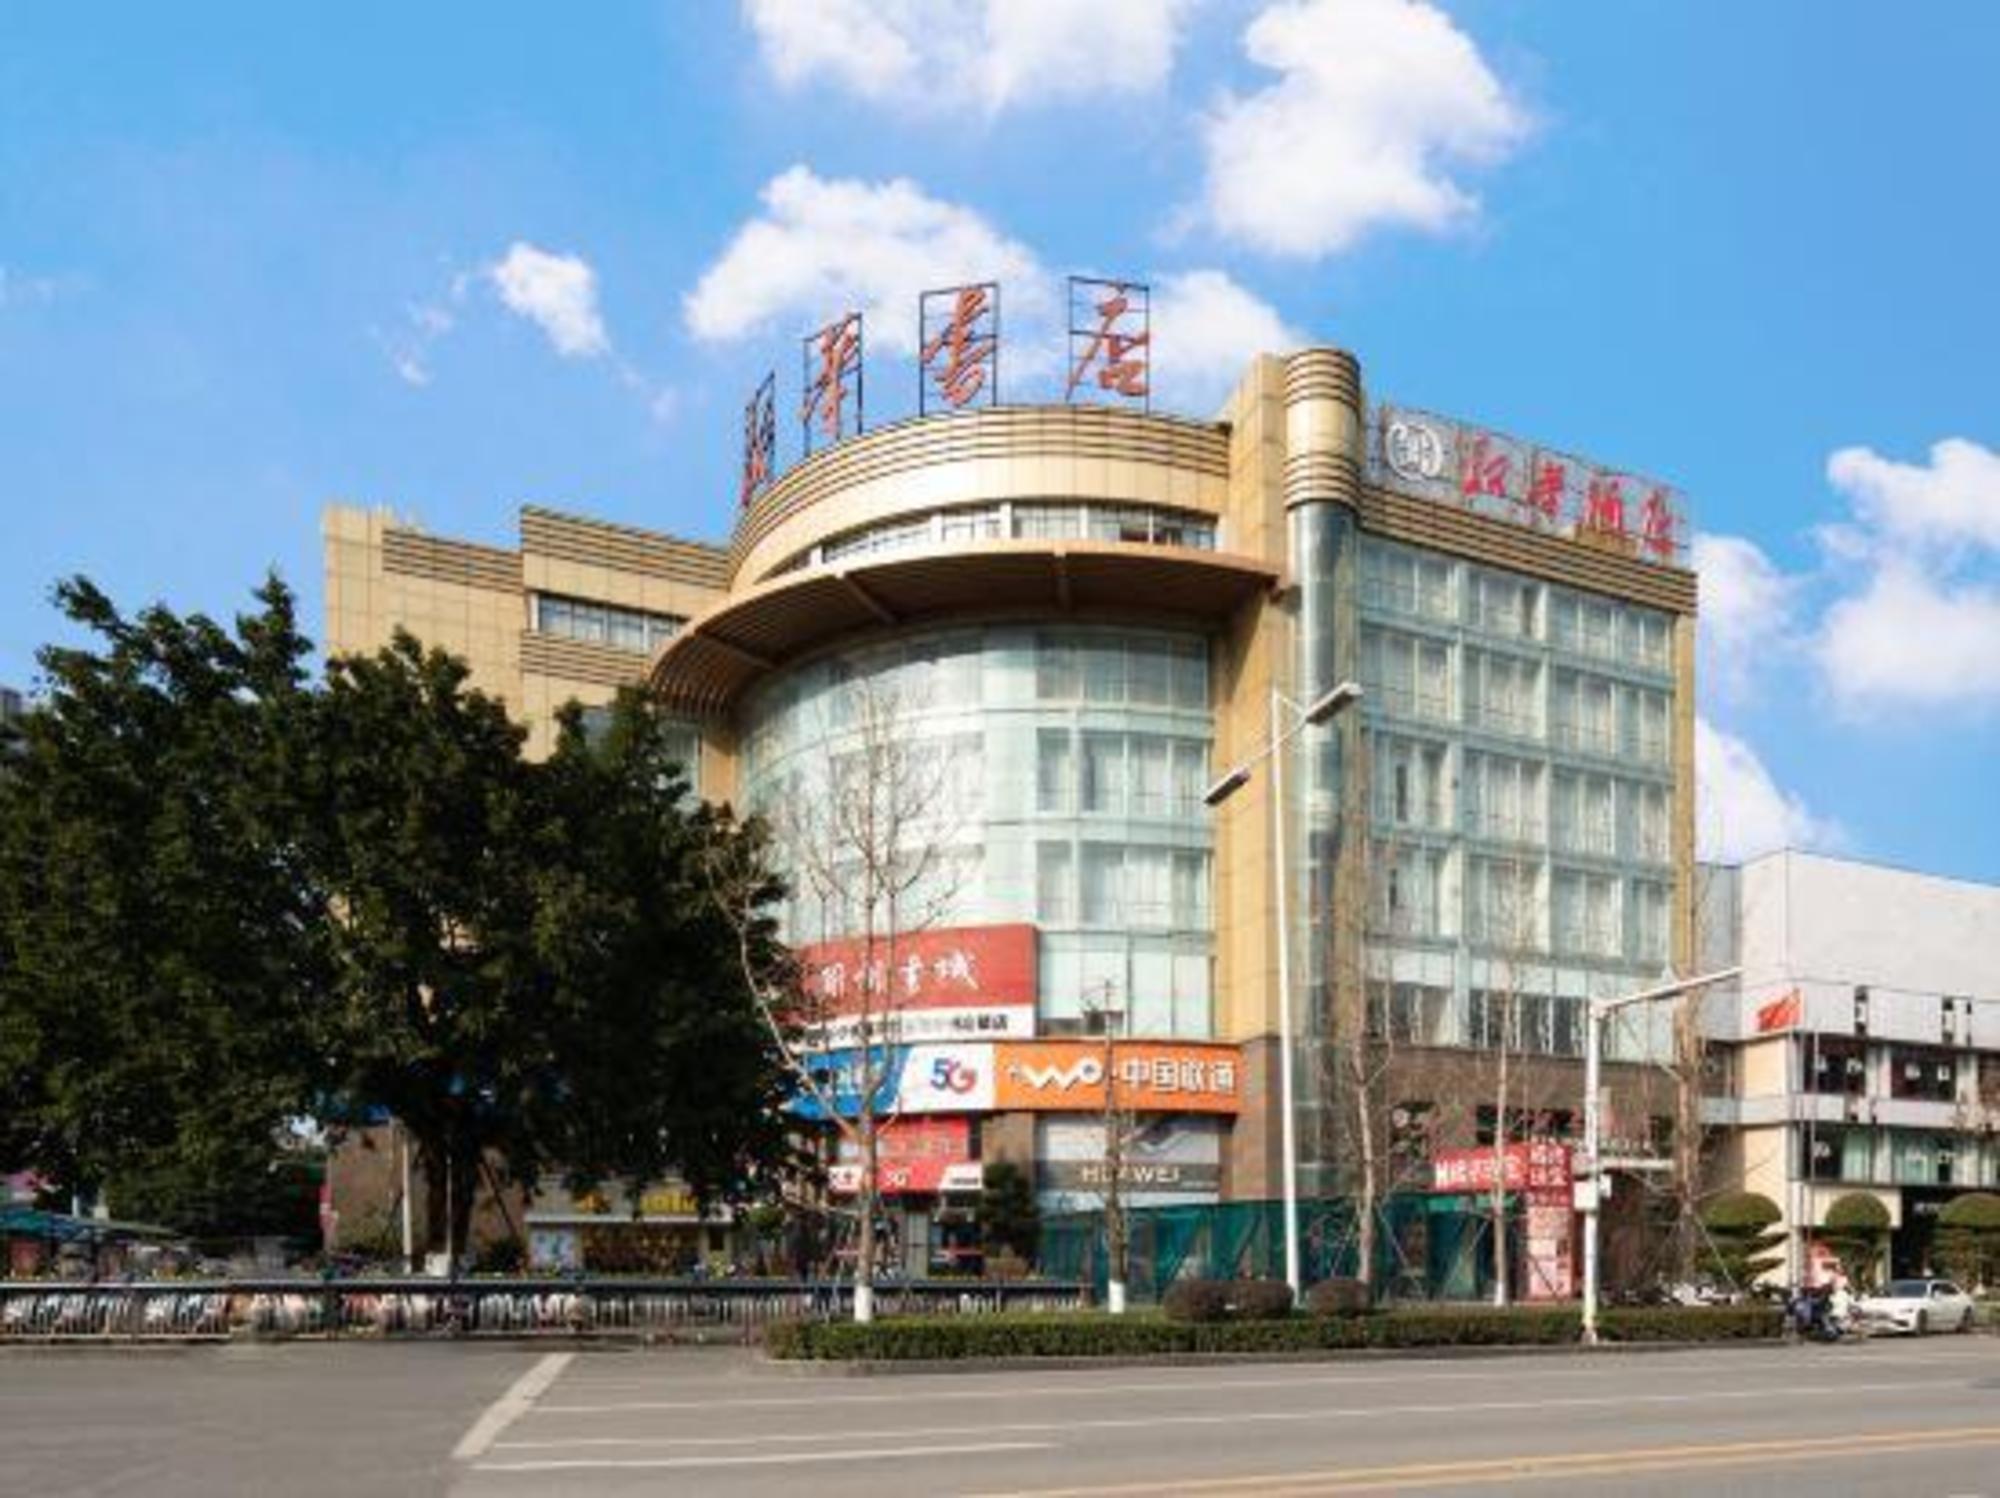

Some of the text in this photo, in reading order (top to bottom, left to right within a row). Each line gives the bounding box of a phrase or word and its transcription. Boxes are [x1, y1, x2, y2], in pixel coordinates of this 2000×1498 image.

[930, 1057, 977, 1094] 5G
[1121, 1057, 1235, 1094] 中国联通
